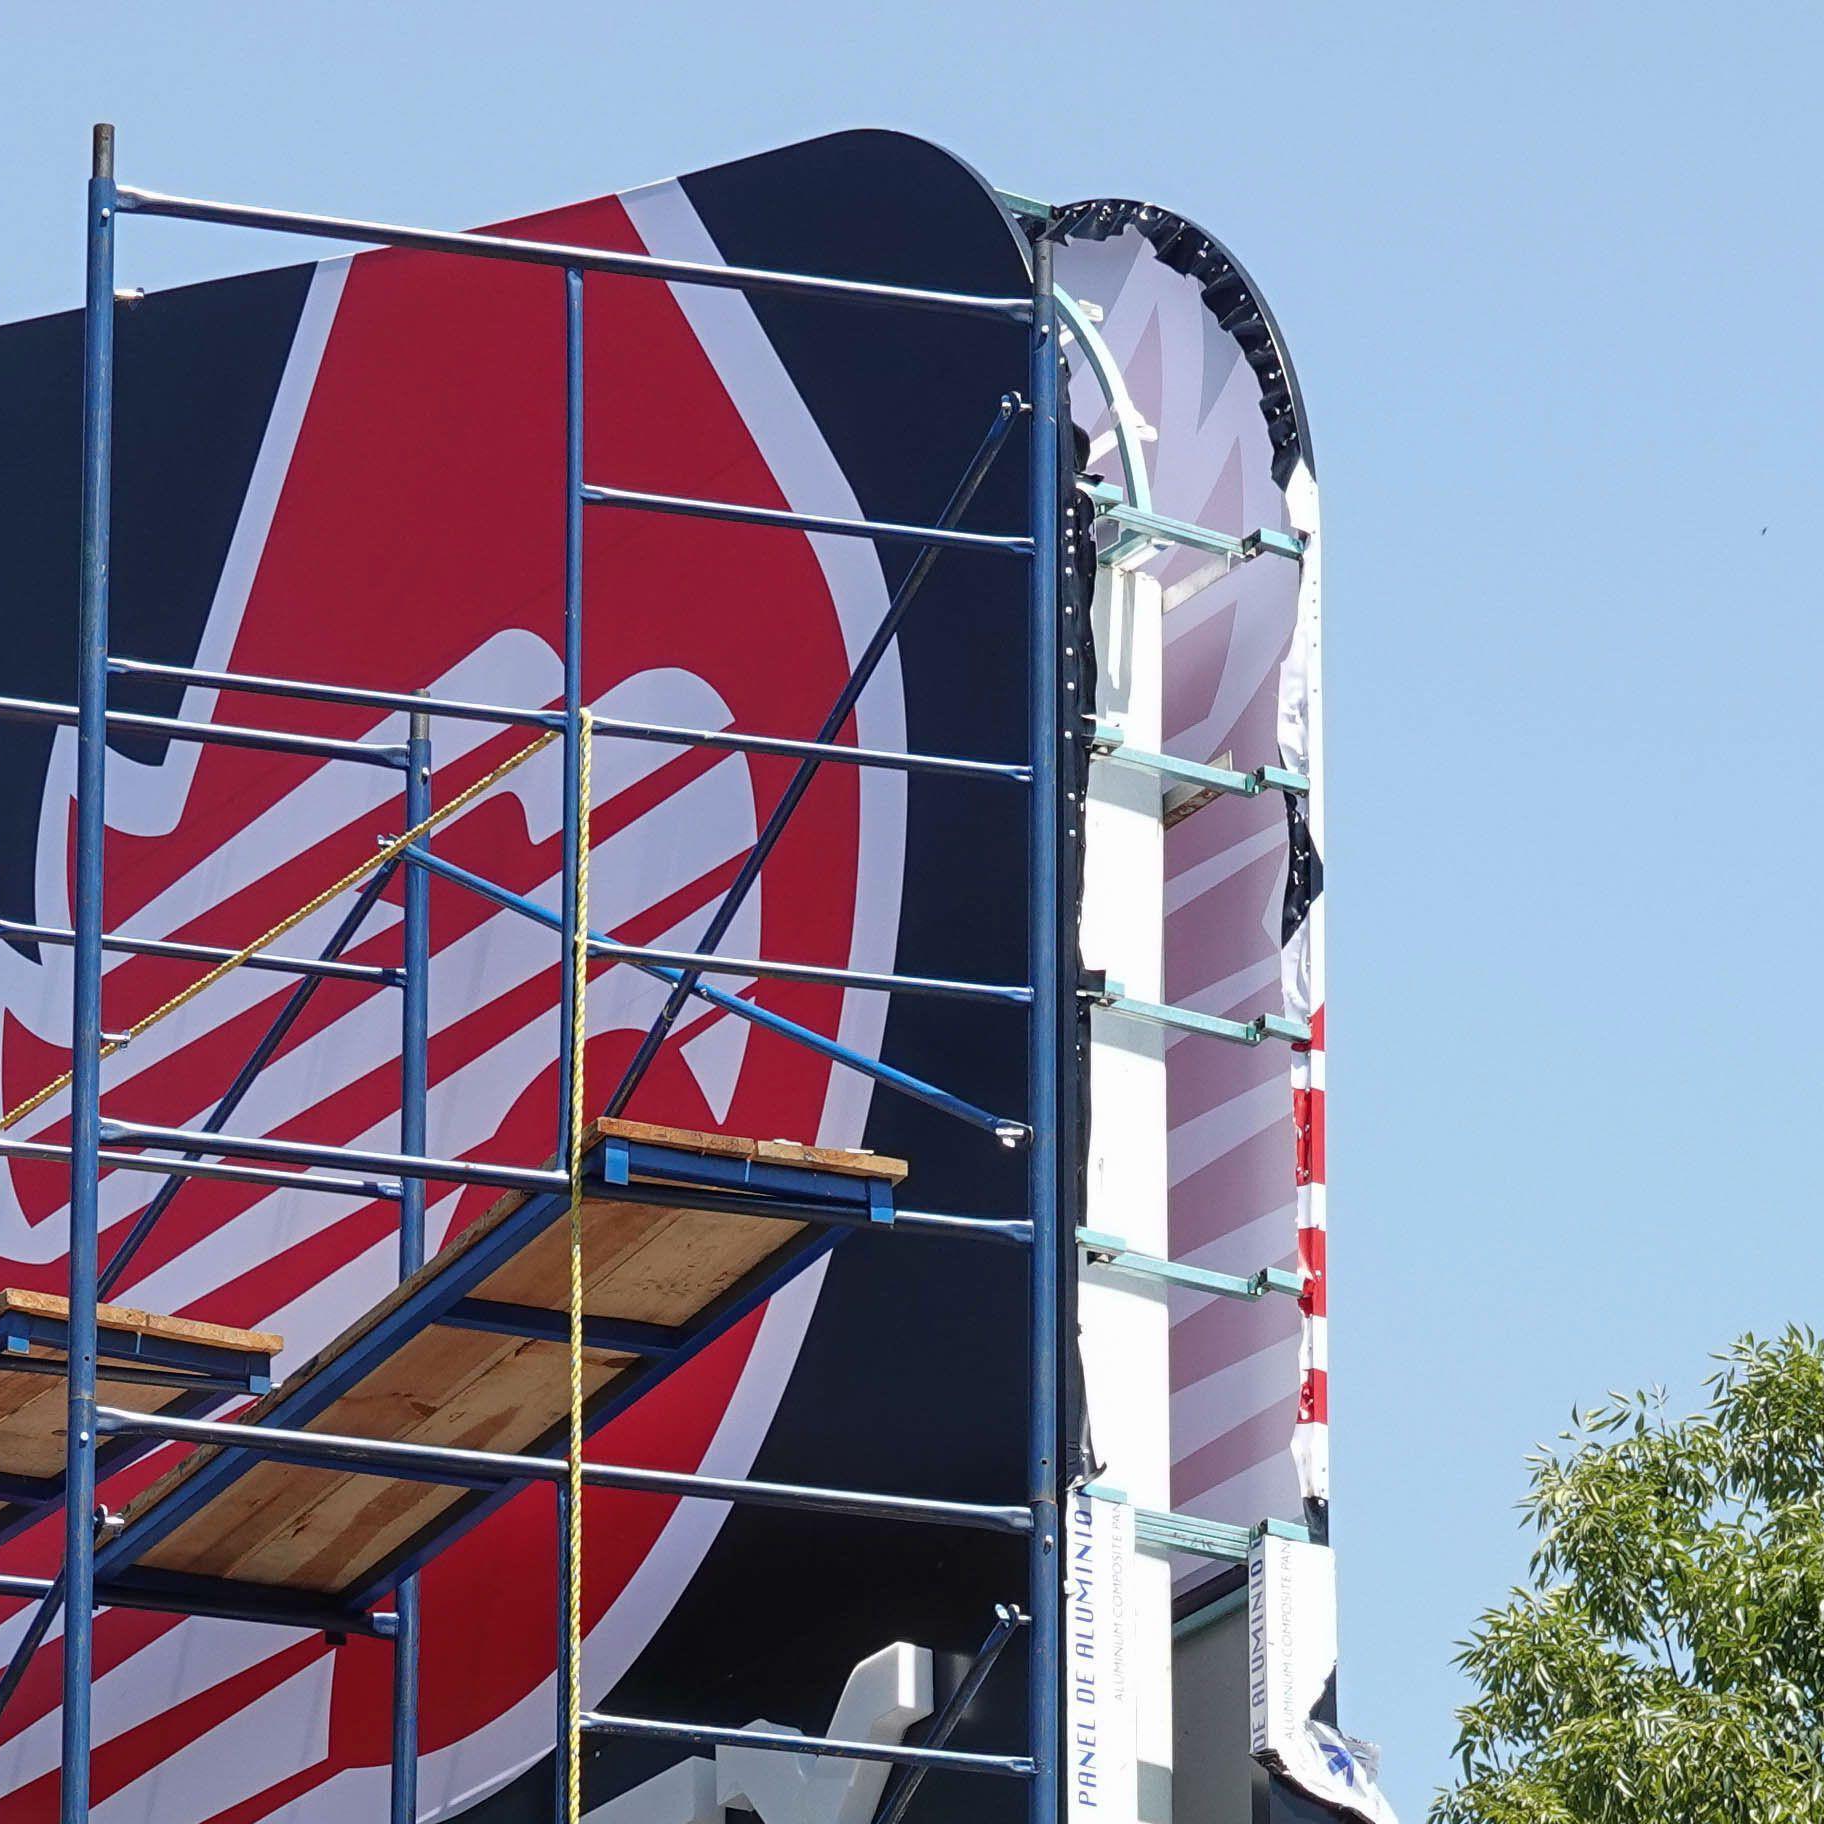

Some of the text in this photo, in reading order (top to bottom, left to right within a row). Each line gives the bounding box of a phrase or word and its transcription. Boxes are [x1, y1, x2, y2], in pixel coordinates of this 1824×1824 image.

[1111, 1534, 1124, 1619] COMPOSITE
[1279, 1574, 1295, 1658] COMPOSITE
[1073, 1509, 1098, 1808] PANEL DE ALUMINIO
[1112, 1622, 1126, 1704] ALUMINUM
[1250, 1558, 1266, 1709] ALUMINIO
